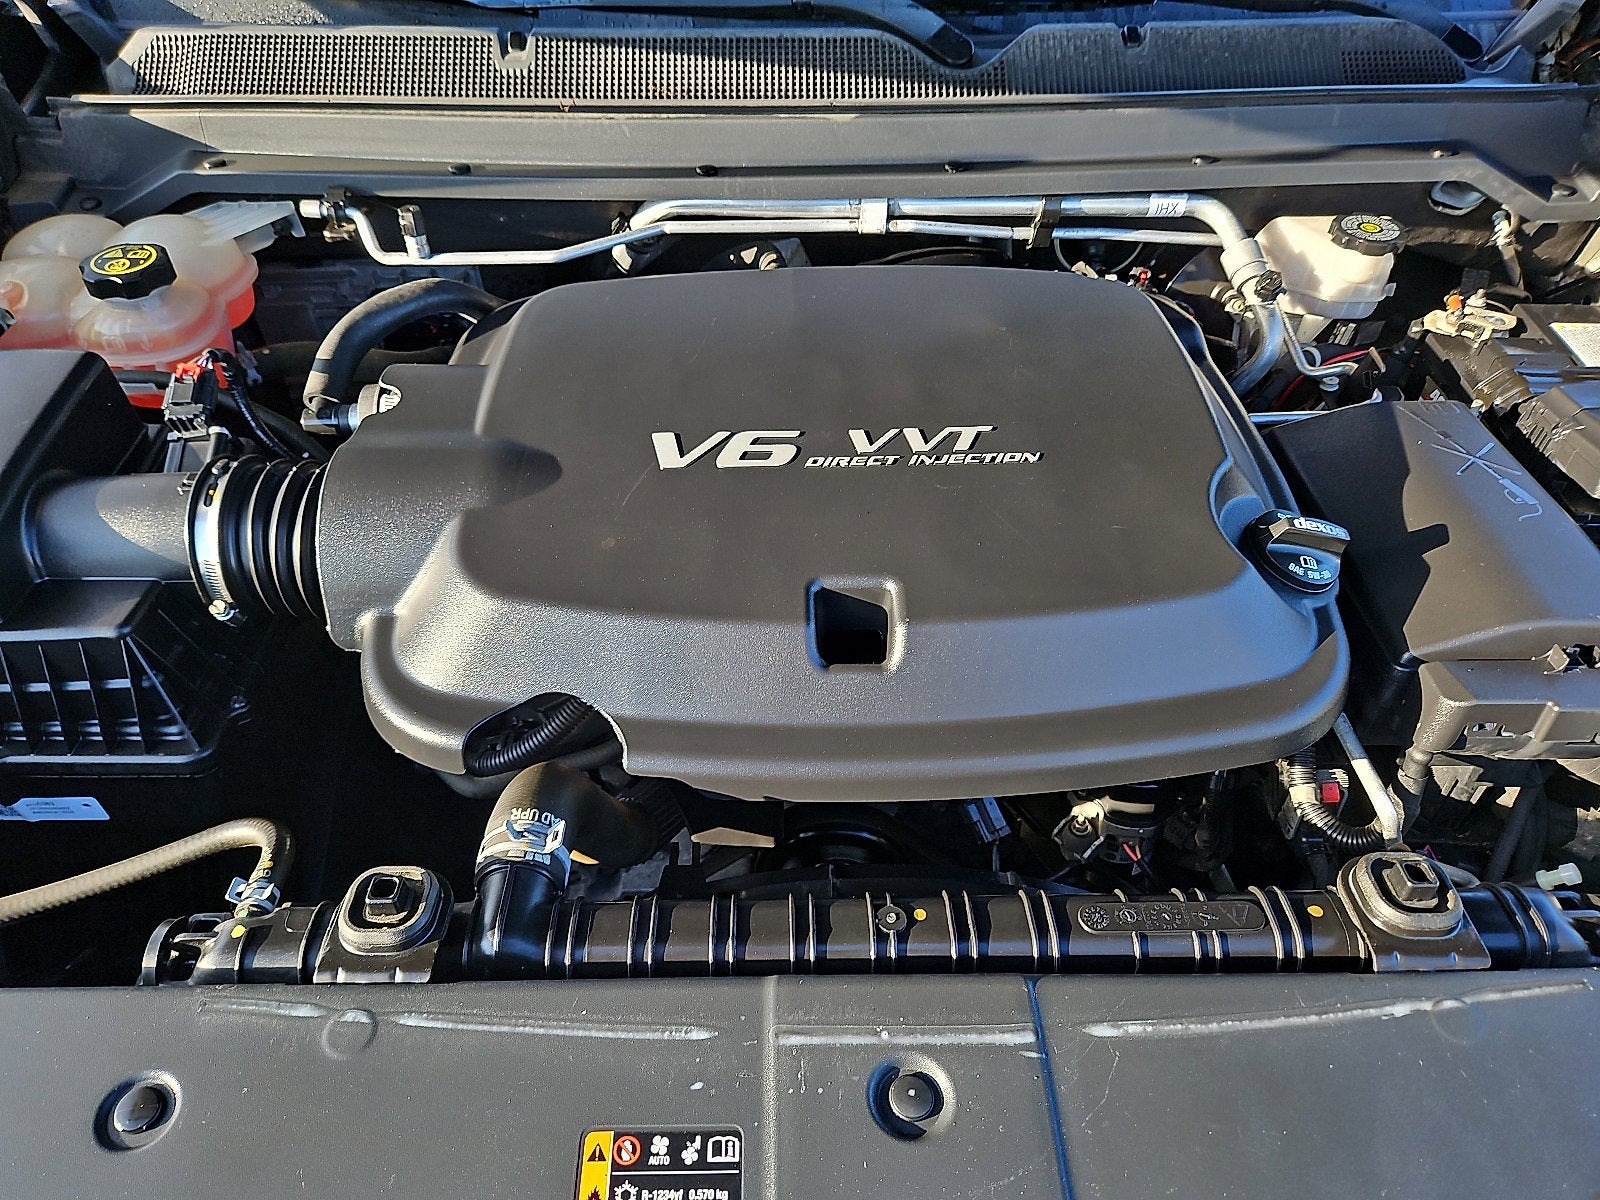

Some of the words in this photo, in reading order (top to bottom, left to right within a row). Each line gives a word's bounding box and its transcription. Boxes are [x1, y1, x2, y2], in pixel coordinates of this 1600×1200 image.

[848, 425, 995, 455] VVT
[651, 430, 801, 471] V6
[804, 455, 902, 469] DIRECT
[907, 451, 1042, 468] INJECTION
[510, 806, 540, 821] UPR
[647, 1155, 671, 1166] AUTO
[688, 1188, 715, 1200] 0.570
